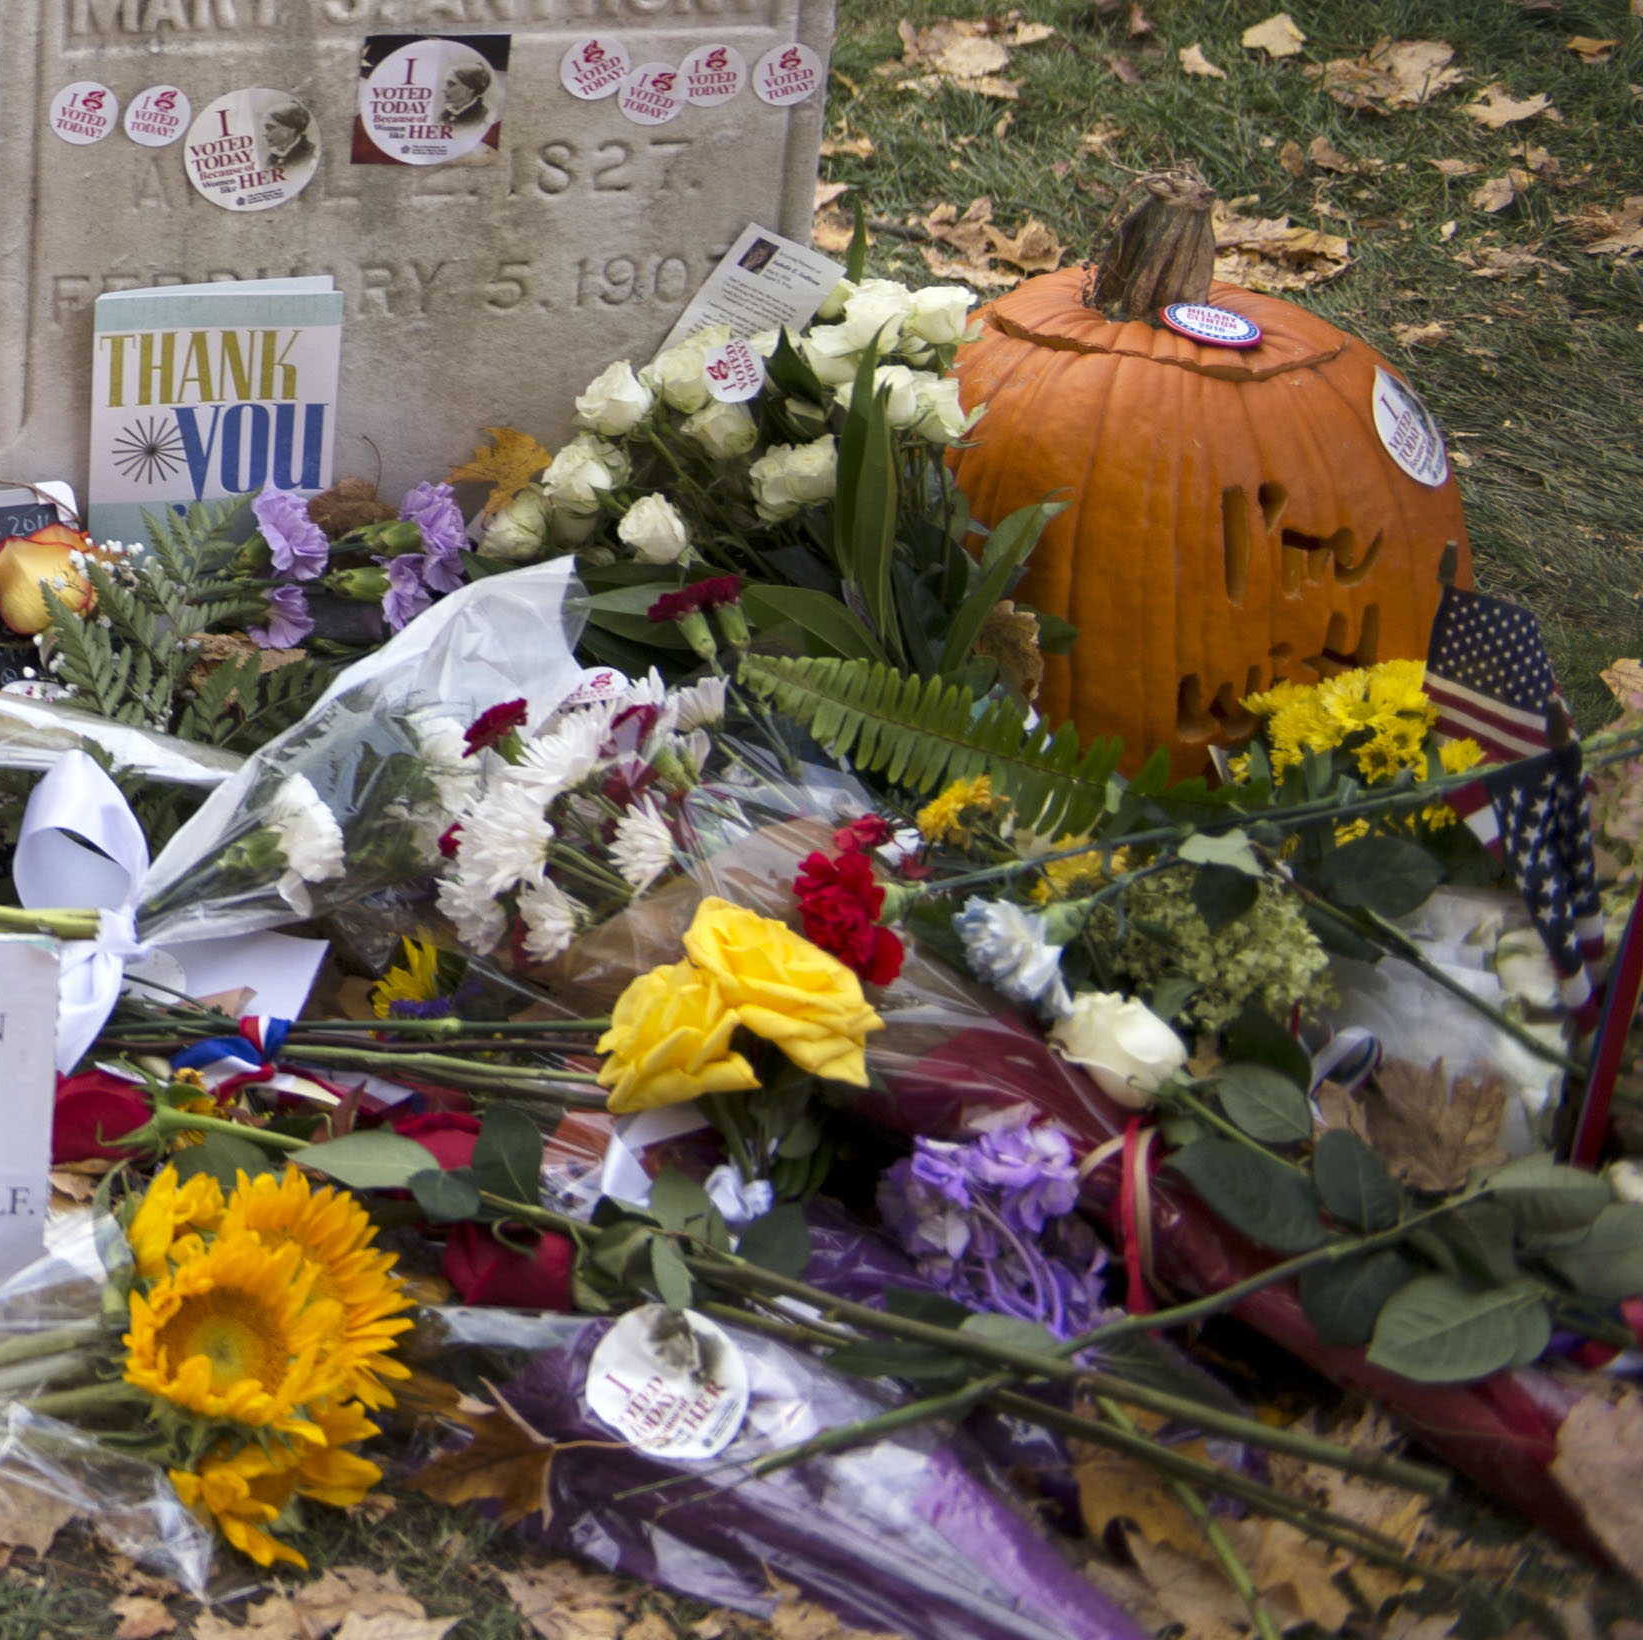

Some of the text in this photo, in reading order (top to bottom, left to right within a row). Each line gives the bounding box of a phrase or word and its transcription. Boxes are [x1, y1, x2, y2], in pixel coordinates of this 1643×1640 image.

[401, 57, 419, 86] I
[694, 59, 701, 74] I
[687, 72, 737, 86] VOTED
[69, 93, 79, 108] I
[371, 87, 433, 100] VOTED
[688, 84, 737, 98] TODAY!
[142, 96, 151, 110] I
[369, 101, 431, 114] TODAY
[61, 106, 108, 128] VOTED
[135, 110, 180, 128] VOTED
[215, 109, 235, 138] I
[56, 118, 103, 139] TODAY!
[130, 121, 176, 139] TODAY!
[407, 124, 454, 140] HER
[189, 135, 253, 158] VOTED
[191, 148, 254, 174] TODAY
[199, 161, 256, 181] Because of
[238, 167, 286, 190] HER
[576, 252, 725, 306] 190
[1186, 313, 1238, 330] CLINTON
[1187, 307, 1237, 323] HILLARY
[1198, 322, 1226, 333] 2016
[100, 330, 302, 408] THANK
[171, 400, 331, 498] YOU
[604, 1371, 633, 1396] I
[682, 1377, 729, 1432] HER
